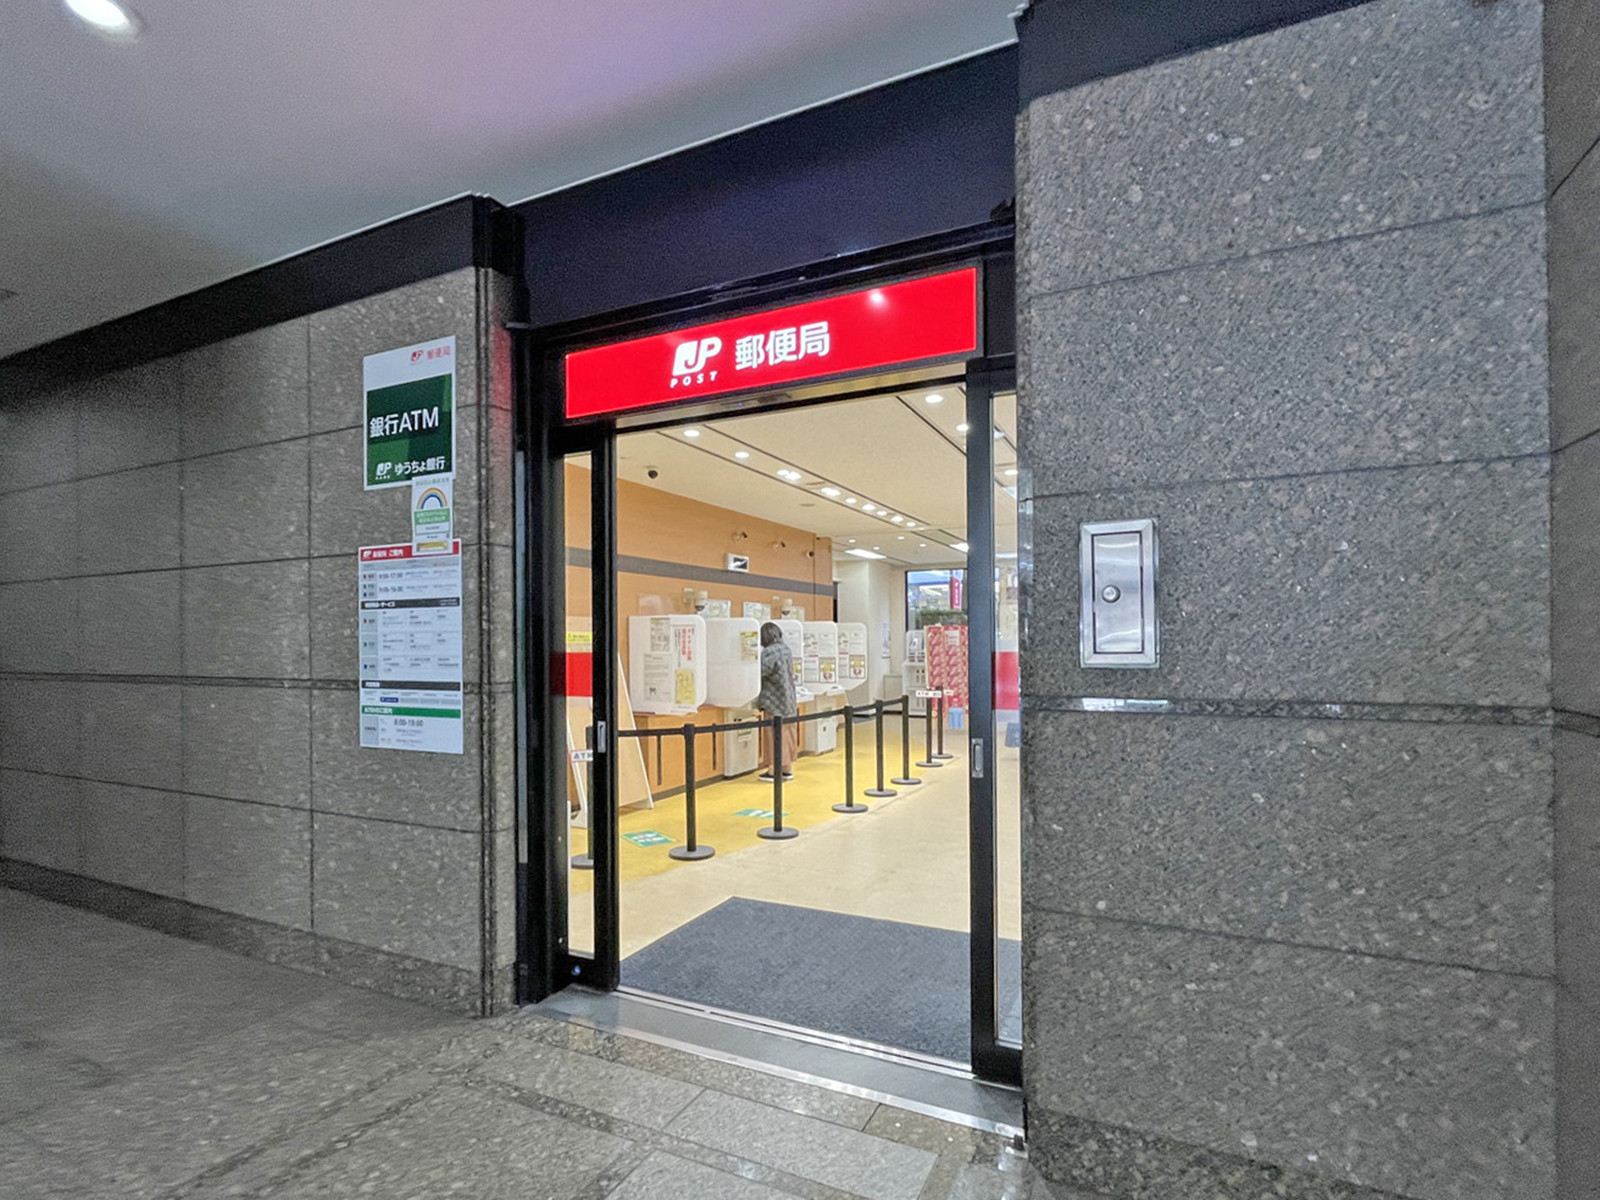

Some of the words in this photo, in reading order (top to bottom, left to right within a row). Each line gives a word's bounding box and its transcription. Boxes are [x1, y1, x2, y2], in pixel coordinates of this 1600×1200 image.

[734, 321, 831, 371] 郵便局
[670, 371, 718, 388] POST
[369, 406, 439, 438] 銀行ATM
[394, 456, 446, 476] ゆうちょ銀行
